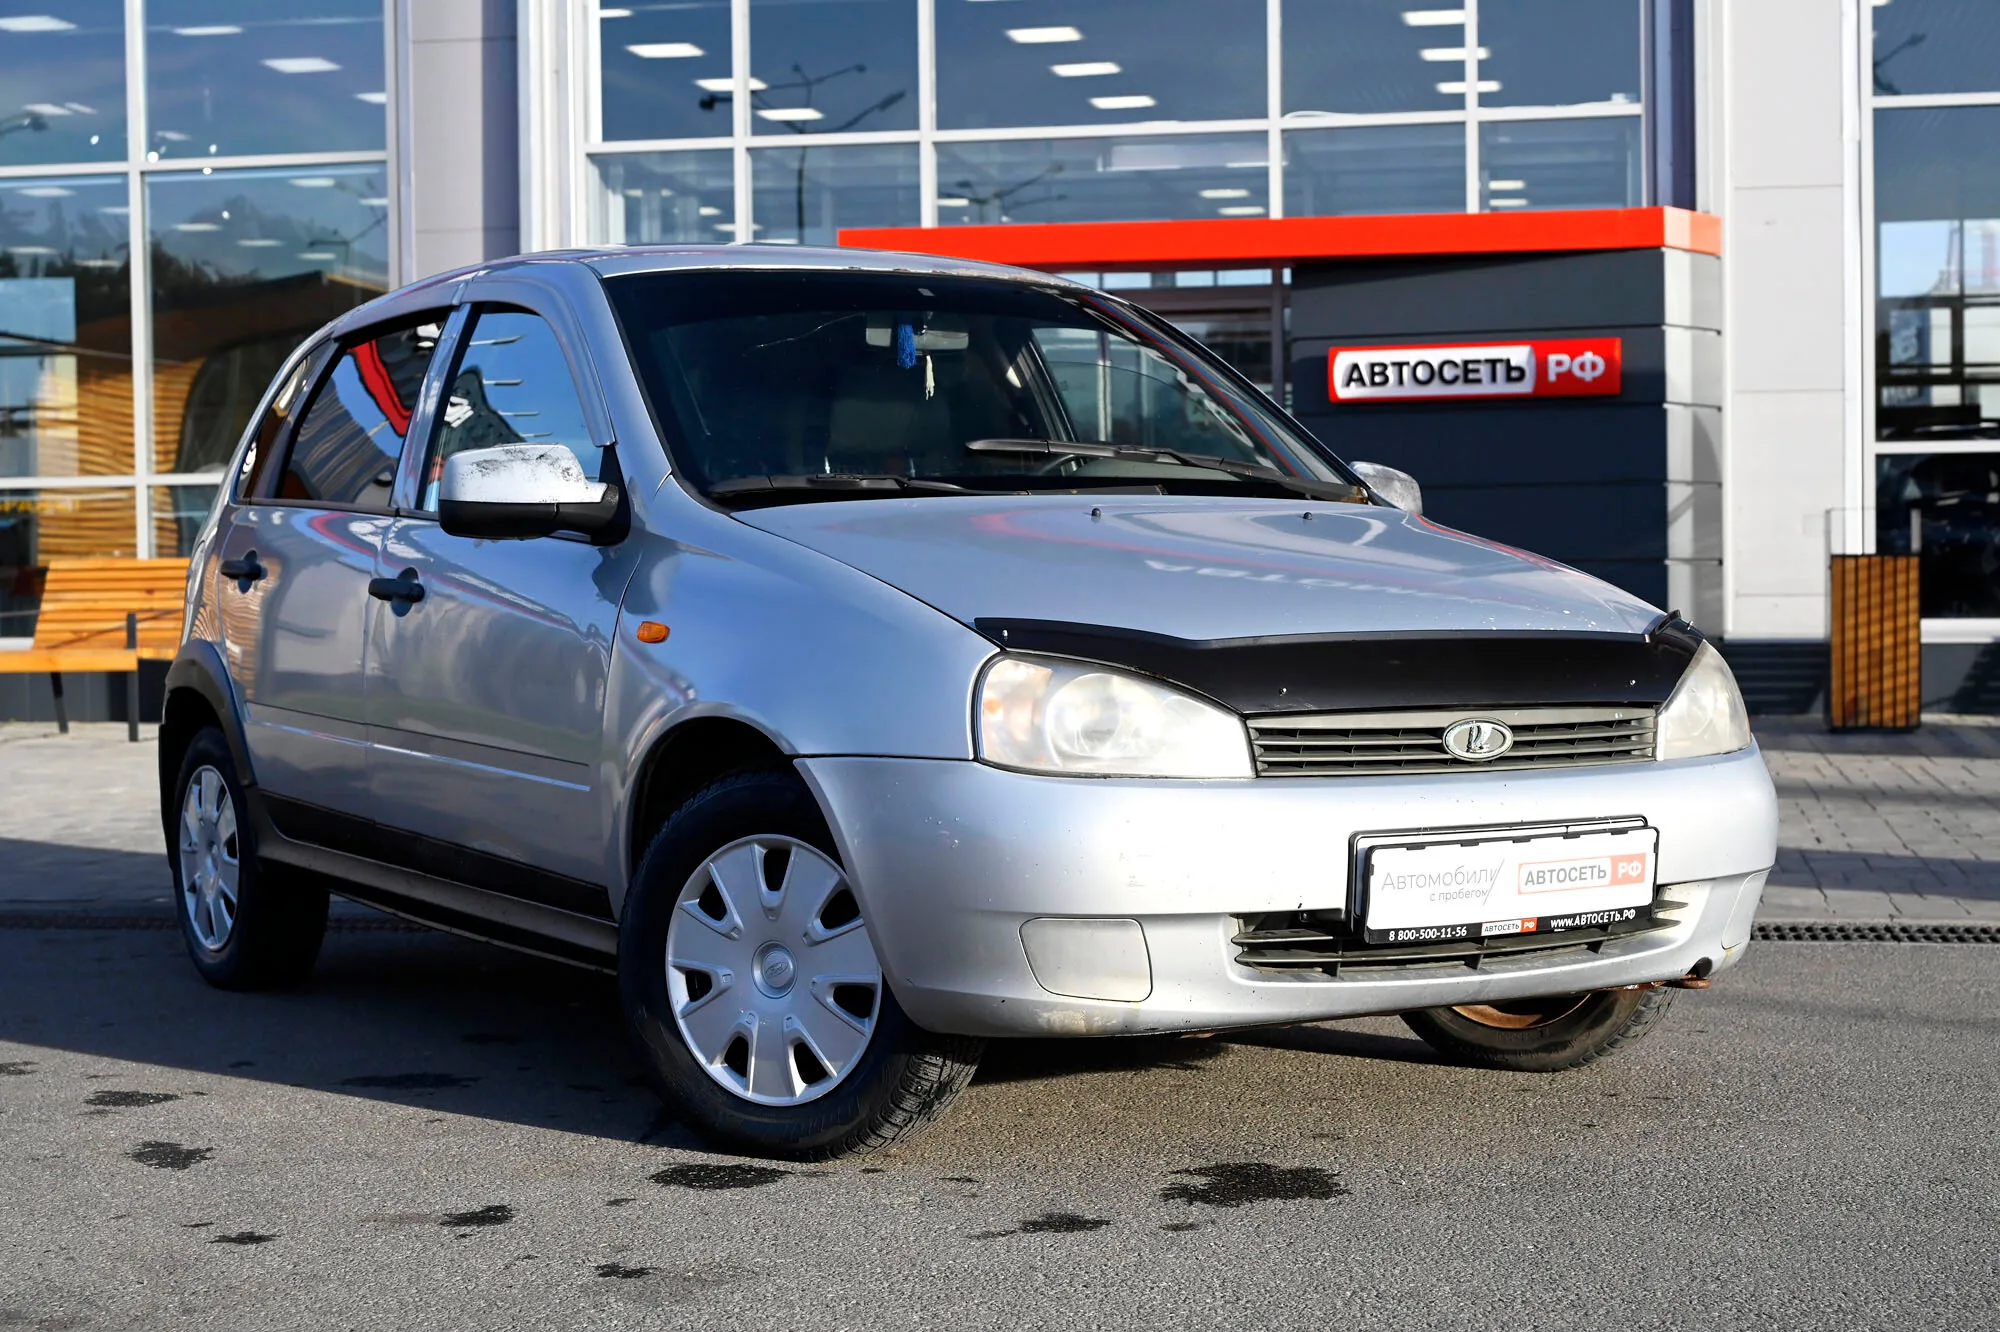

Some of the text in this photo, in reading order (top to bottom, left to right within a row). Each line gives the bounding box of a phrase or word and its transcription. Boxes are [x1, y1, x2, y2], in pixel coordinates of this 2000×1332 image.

[1345, 351, 1606, 388] АВТОСЕТЬ РФ
[1524, 859, 1642, 887] АВТОСЕТЬ РФ
[1438, 888, 1489, 903] пробегом
[1484, 919, 1535, 933] АВТОСЕТЬ РФ
[1550, 908, 1636, 928] www.АВТОСЕТЬ.РФ
[1388, 926, 1468, 941] 8 800-500-11-56
